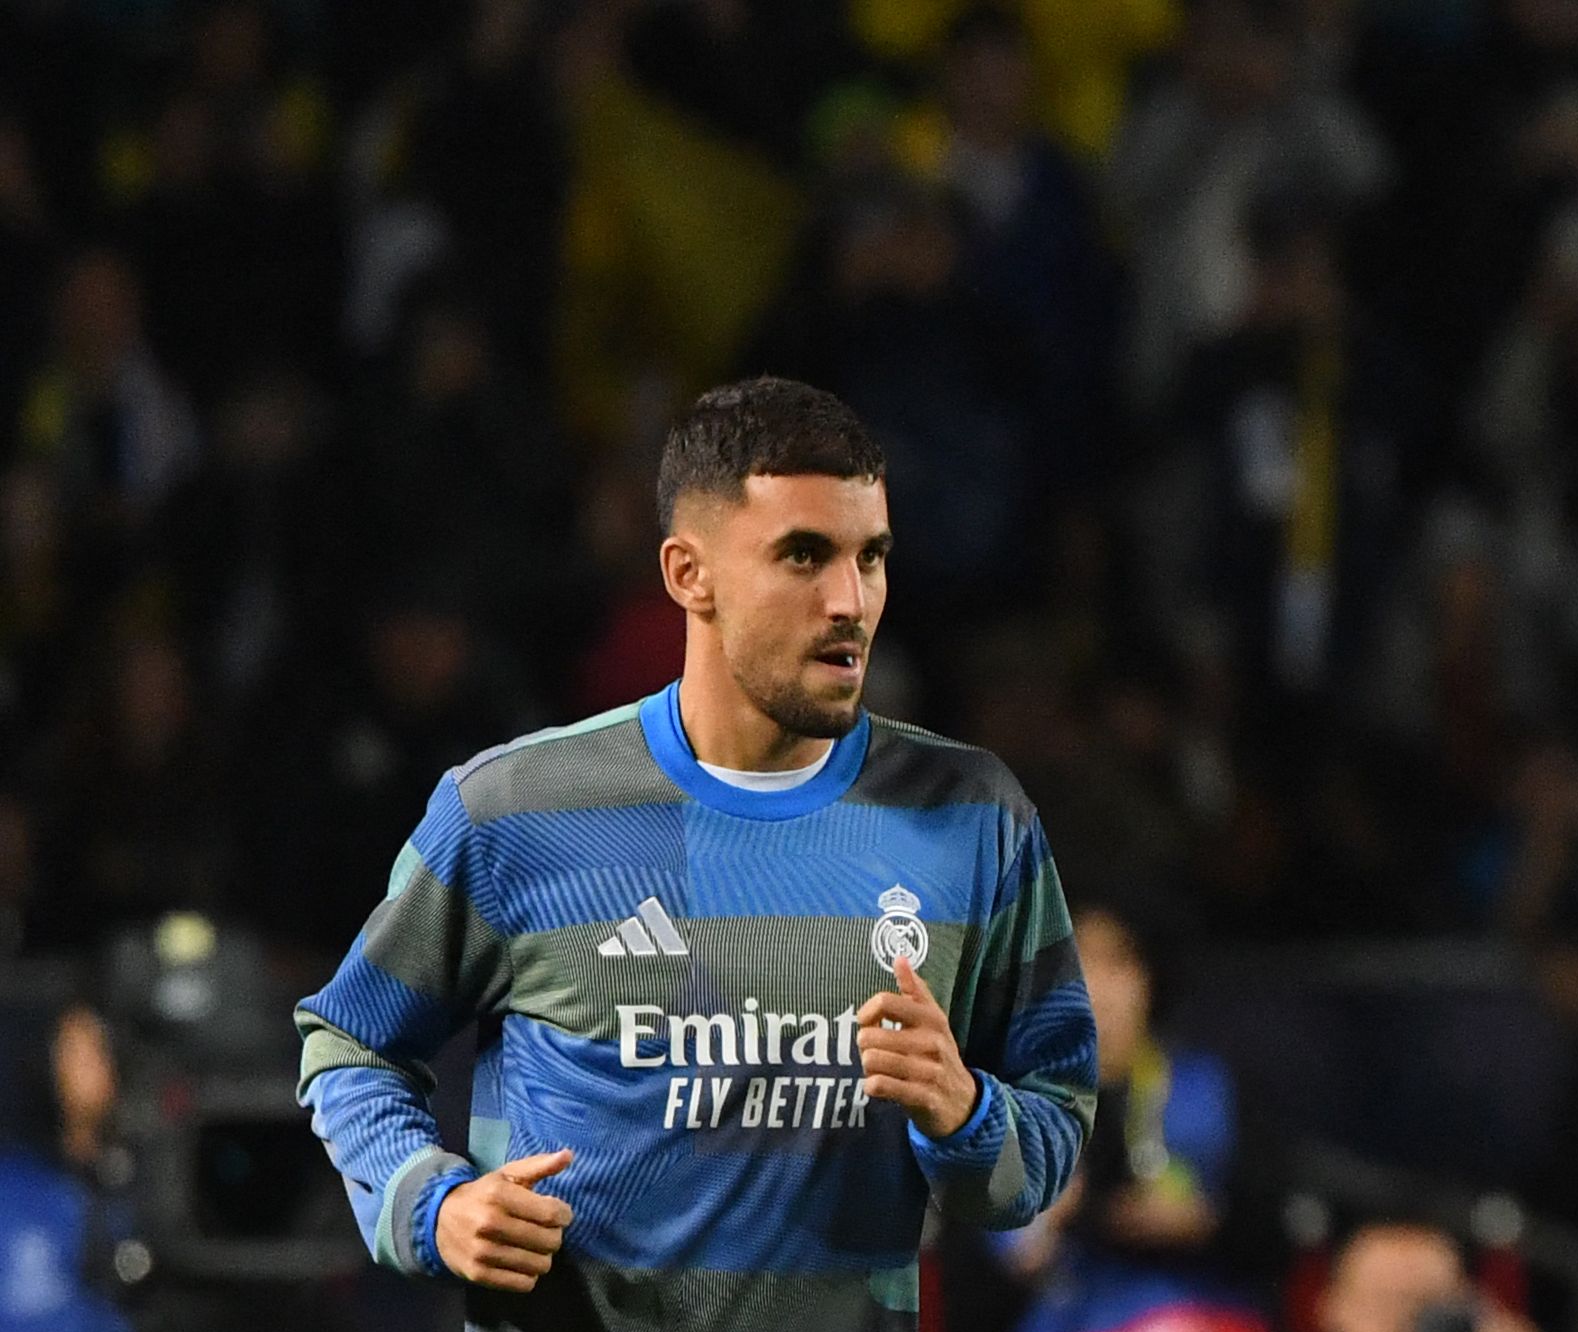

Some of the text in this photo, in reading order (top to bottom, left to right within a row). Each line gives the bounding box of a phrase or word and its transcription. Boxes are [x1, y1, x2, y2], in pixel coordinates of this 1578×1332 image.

[616, 997, 903, 1068] Emirat
[663, 1077, 870, 1129] FLY BETTER
